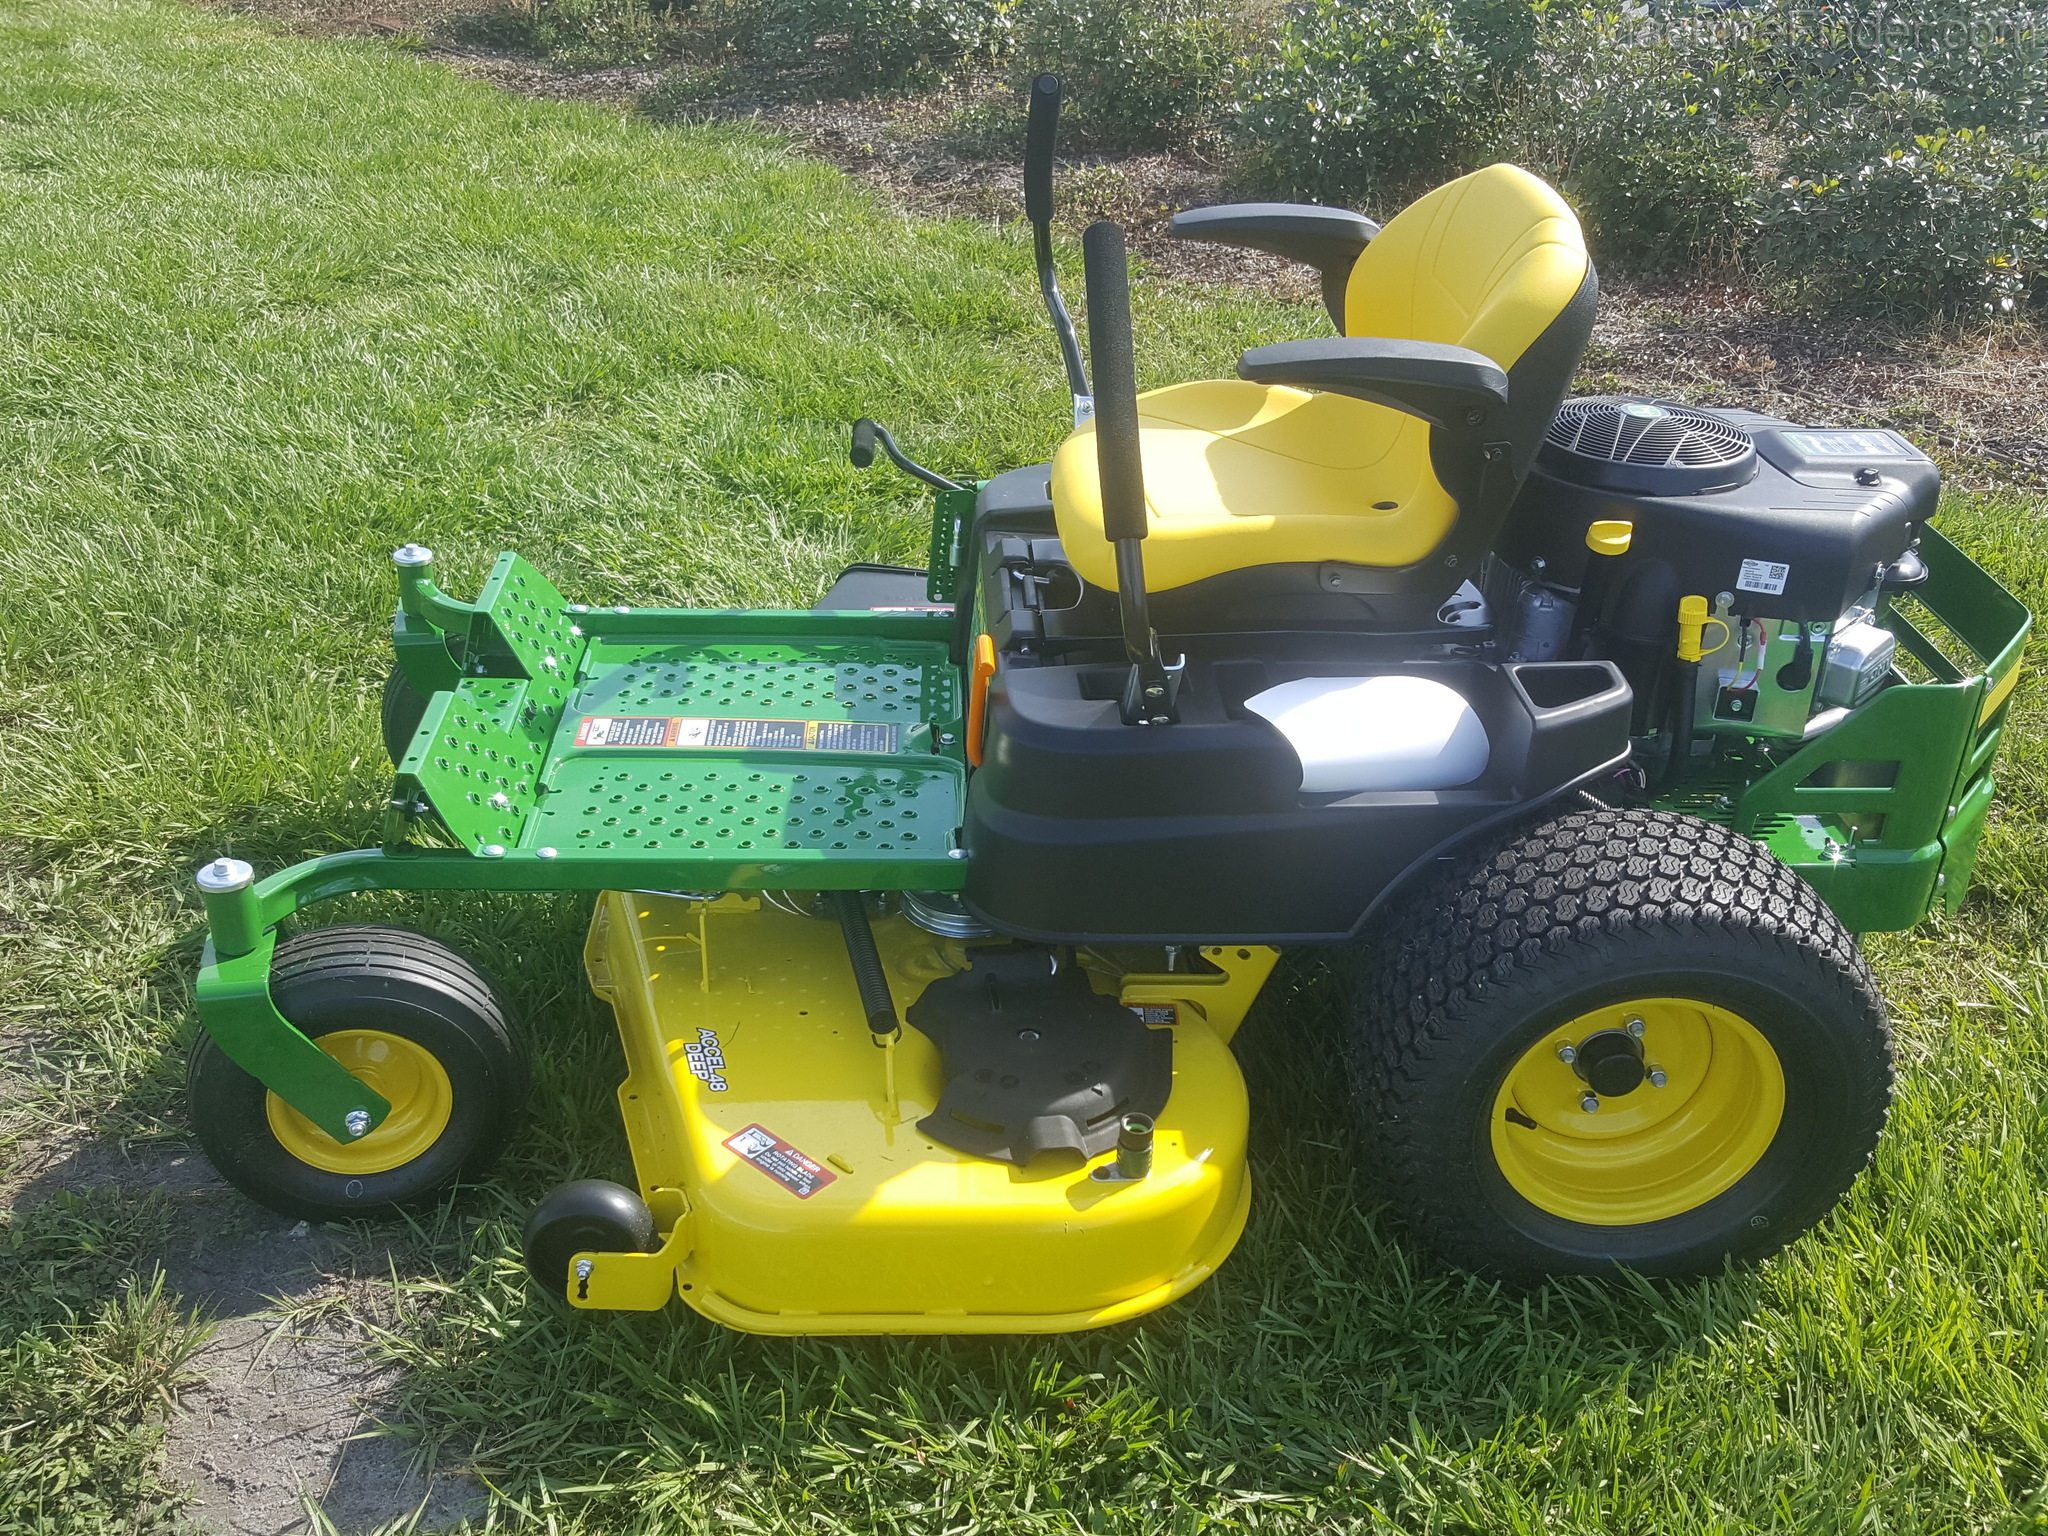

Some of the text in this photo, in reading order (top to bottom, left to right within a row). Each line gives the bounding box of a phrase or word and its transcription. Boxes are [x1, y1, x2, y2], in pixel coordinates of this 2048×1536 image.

[684, 1043, 709, 1081] DEEP
[773, 1151, 815, 1179] ROTATING BLADE
[792, 1153, 821, 1172] DANGER
